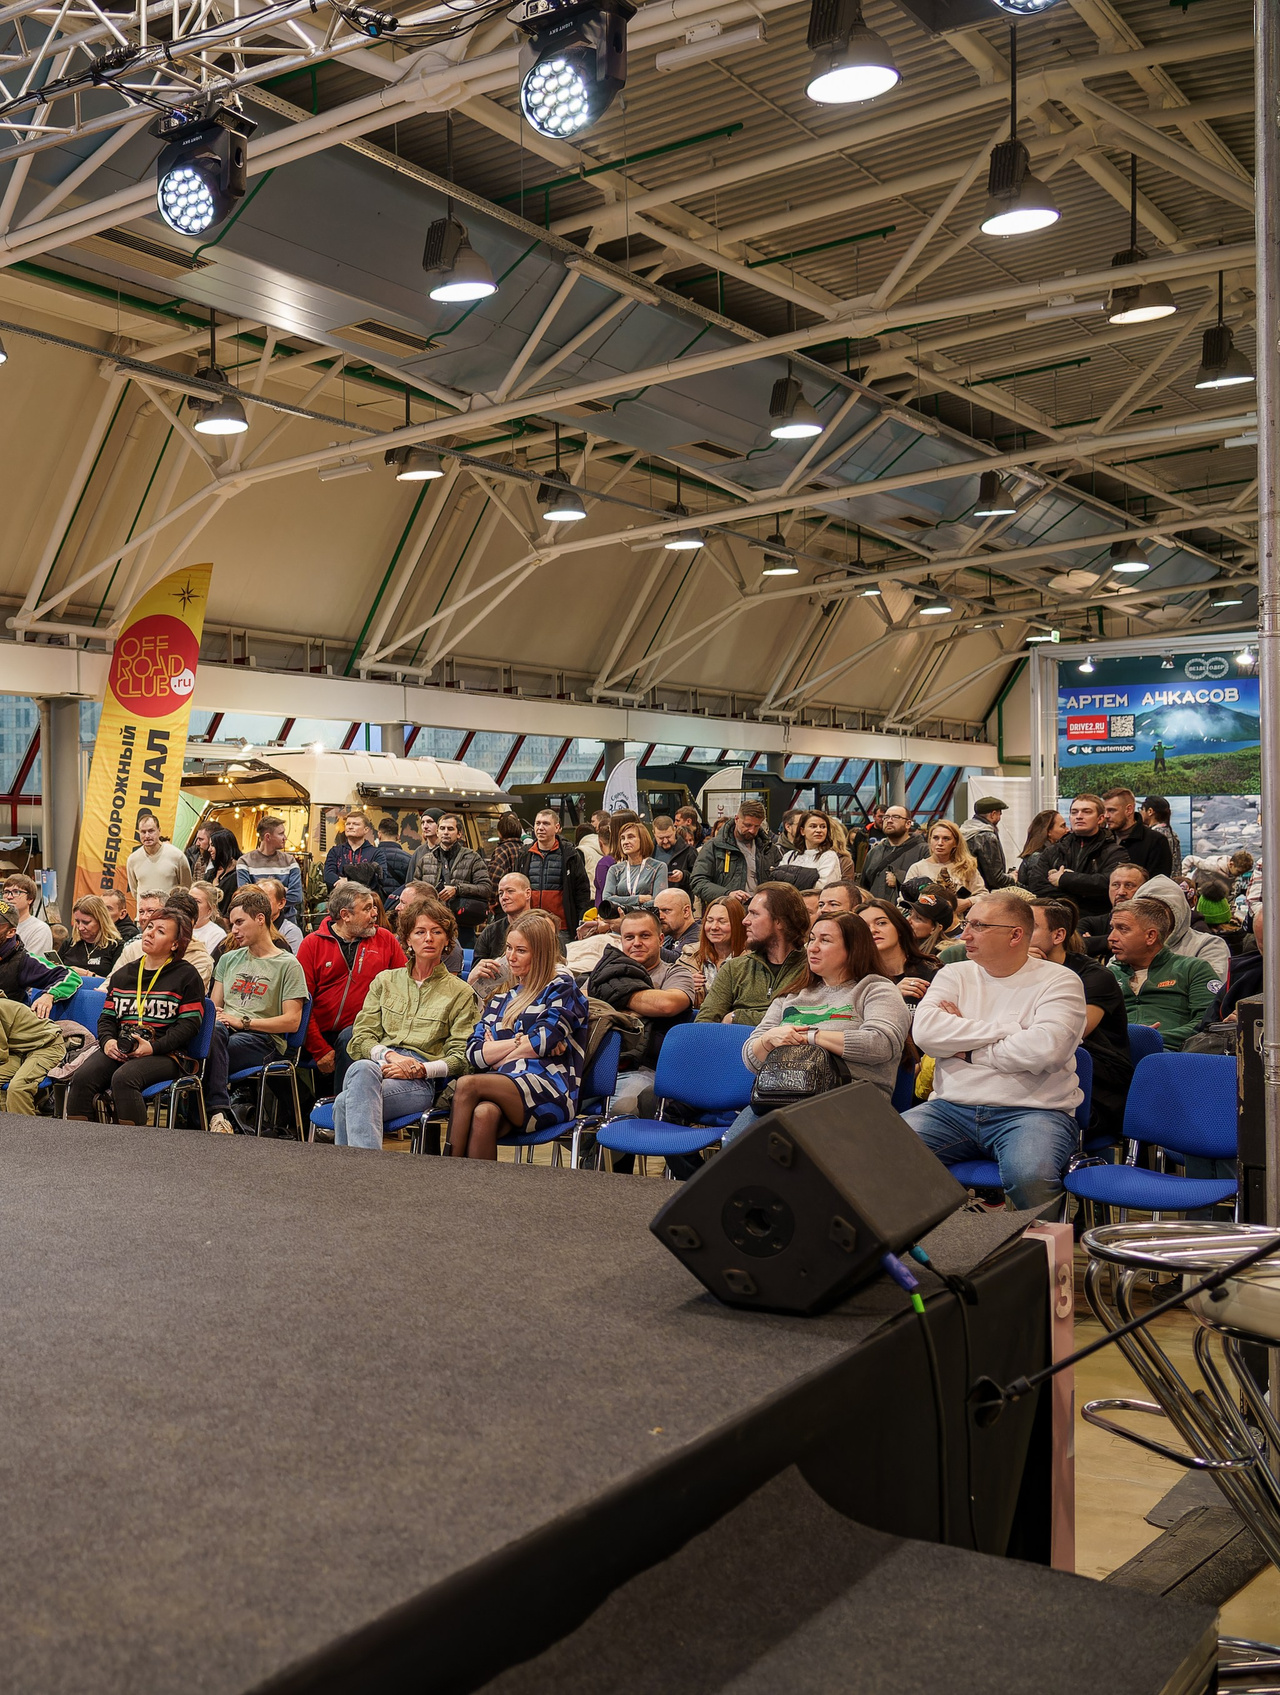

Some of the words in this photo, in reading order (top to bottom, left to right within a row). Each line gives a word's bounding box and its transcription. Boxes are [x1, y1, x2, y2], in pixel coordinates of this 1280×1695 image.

[120, 636, 169, 659] OFF
[117, 654, 185, 679] ROAD
[116, 675, 170, 697] CLUB
[1066, 693, 1129, 709] АРТЕМ
[1141, 687, 1240, 706] АЧКАСОВ
[1069, 722, 1105, 731] DRIVE2.RU
[1095, 745, 1134, 753] @artemspec
[100, 725, 137, 890] ВНЕДОРОЖНЫЙ
[1056, 1263, 1072, 1318] 3
